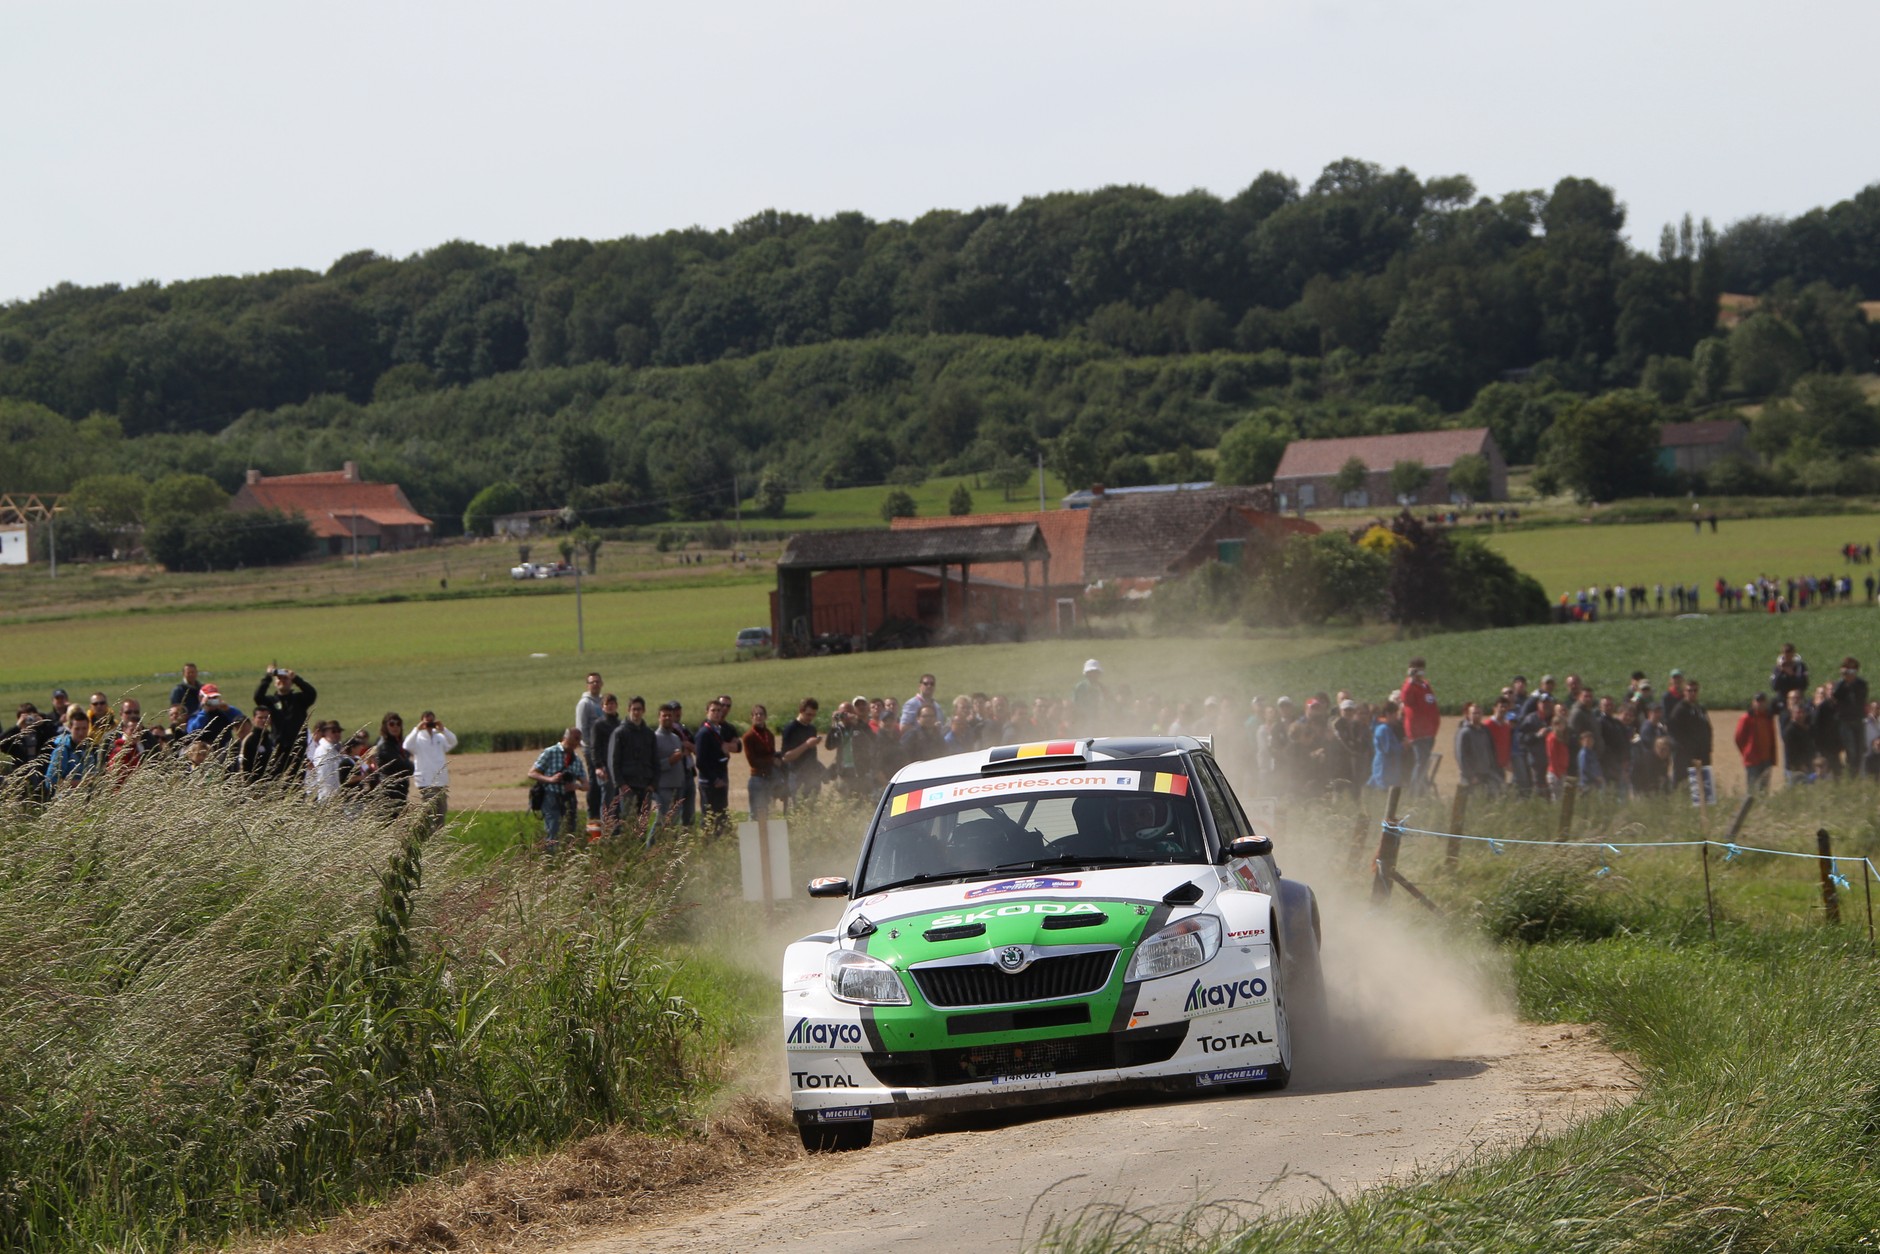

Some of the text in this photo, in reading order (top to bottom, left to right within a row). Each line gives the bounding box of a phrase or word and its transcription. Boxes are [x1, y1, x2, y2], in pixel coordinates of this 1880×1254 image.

[952, 776, 1107, 797] ircseries.com
[931, 903, 1103, 929] ŠKODA
[1227, 929, 1265, 938] WEVERS
[1197, 1031, 1273, 1053] TOTAL
[792, 1072, 859, 1088] TOTAL
[1213, 1069, 1264, 1081] MICHELIN
[825, 1108, 867, 1118] MICHELIN
